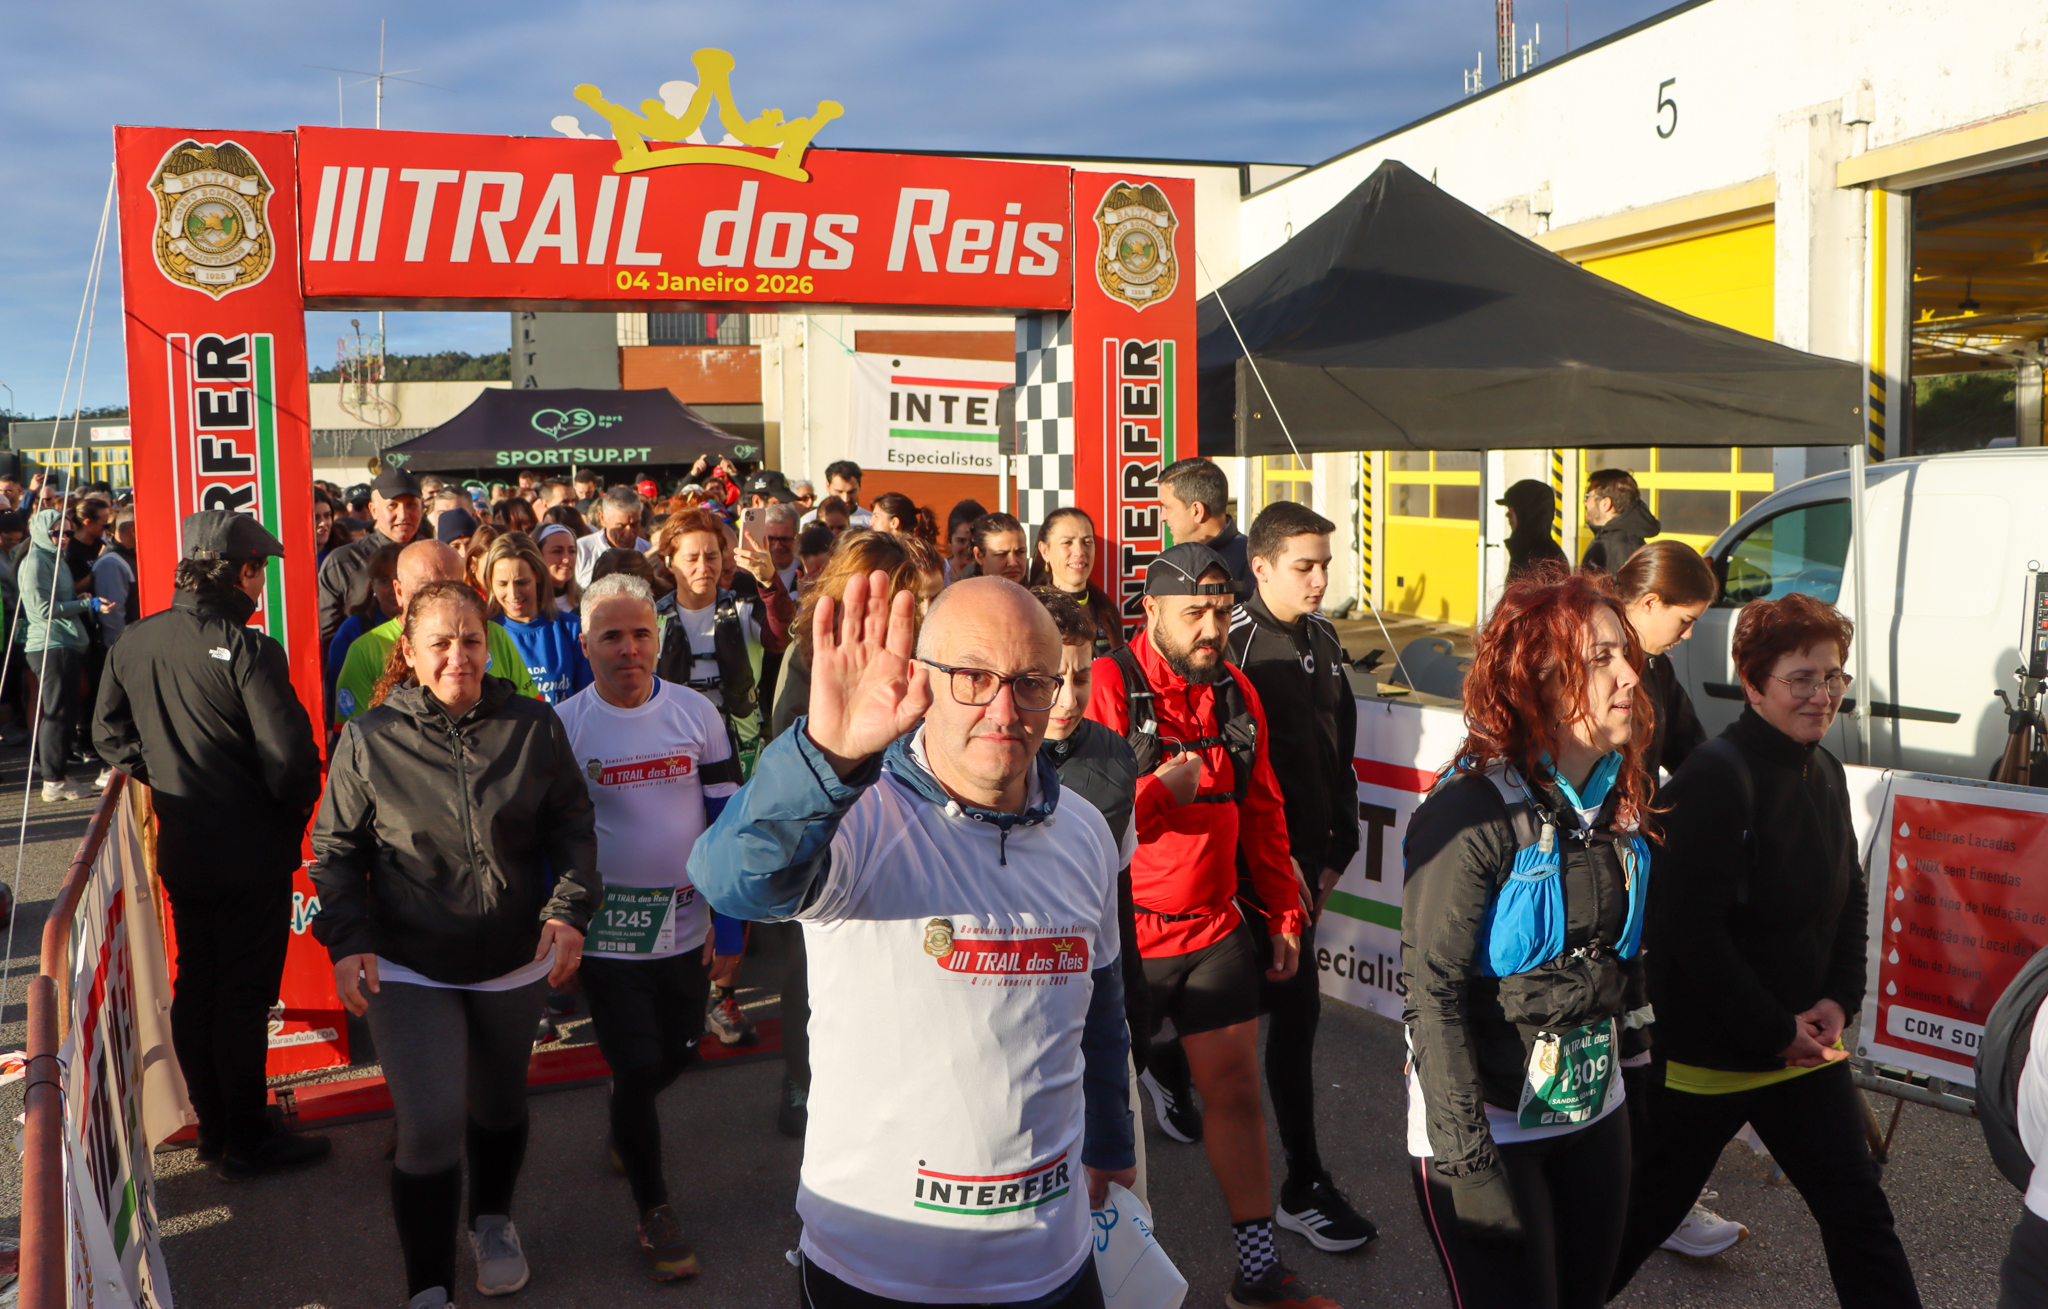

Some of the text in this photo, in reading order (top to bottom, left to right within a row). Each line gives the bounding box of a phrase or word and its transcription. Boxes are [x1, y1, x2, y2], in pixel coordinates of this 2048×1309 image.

[1656, 76, 1677, 139] 5
[180, 172, 241, 190] BALTAR
[174, 189, 252, 222] CORPO BOMBEIROS
[1116, 208, 1157, 224] BALTAR
[698, 180, 859, 270] dos
[887, 187, 1064, 276] Reis
[1112, 221, 1164, 249] CORPO BOMBEIROS
[206, 272, 226, 280] 1928
[616, 271, 814, 294] 04 Janeiro 2026
[889, 391, 1000, 427] INTE
[196, 336, 254, 513] RFER
[496, 447, 652, 468] SPORTSUP.PT
[887, 449, 993, 467] Especialistas
[603, 764, 688, 785] III TRAIL dos Reis
[1918, 825, 2016, 852] Caleiras Lacadas
[1915, 858, 2021, 887] INOX sem Emendas
[604, 910, 652, 927] 1245
[1914, 890, 2047, 926] Todo tipo de Vedação de
[1909, 922, 1958, 945] Produção
[1962, 934, 1976, 947] no
[1980, 936, 2010, 954] Local
[2014, 942, 2028, 956] de
[949, 951, 1083, 971] III TRAIL dos Reis
[1907, 953, 1982, 981] Tubo de Jardim
[1049, 976, 1068, 986] 2026
[295, 1034, 315, 1042] Auto
[317, 1030, 335, 1039] LDA
[1594, 1033, 1609, 1046] dos
[1905, 1017, 1944, 1040] COM
[1560, 1054, 1609, 1092] 1309
[1552, 1096, 1579, 1105] SANDRA
[915, 1162, 1070, 1206] INTERFER
